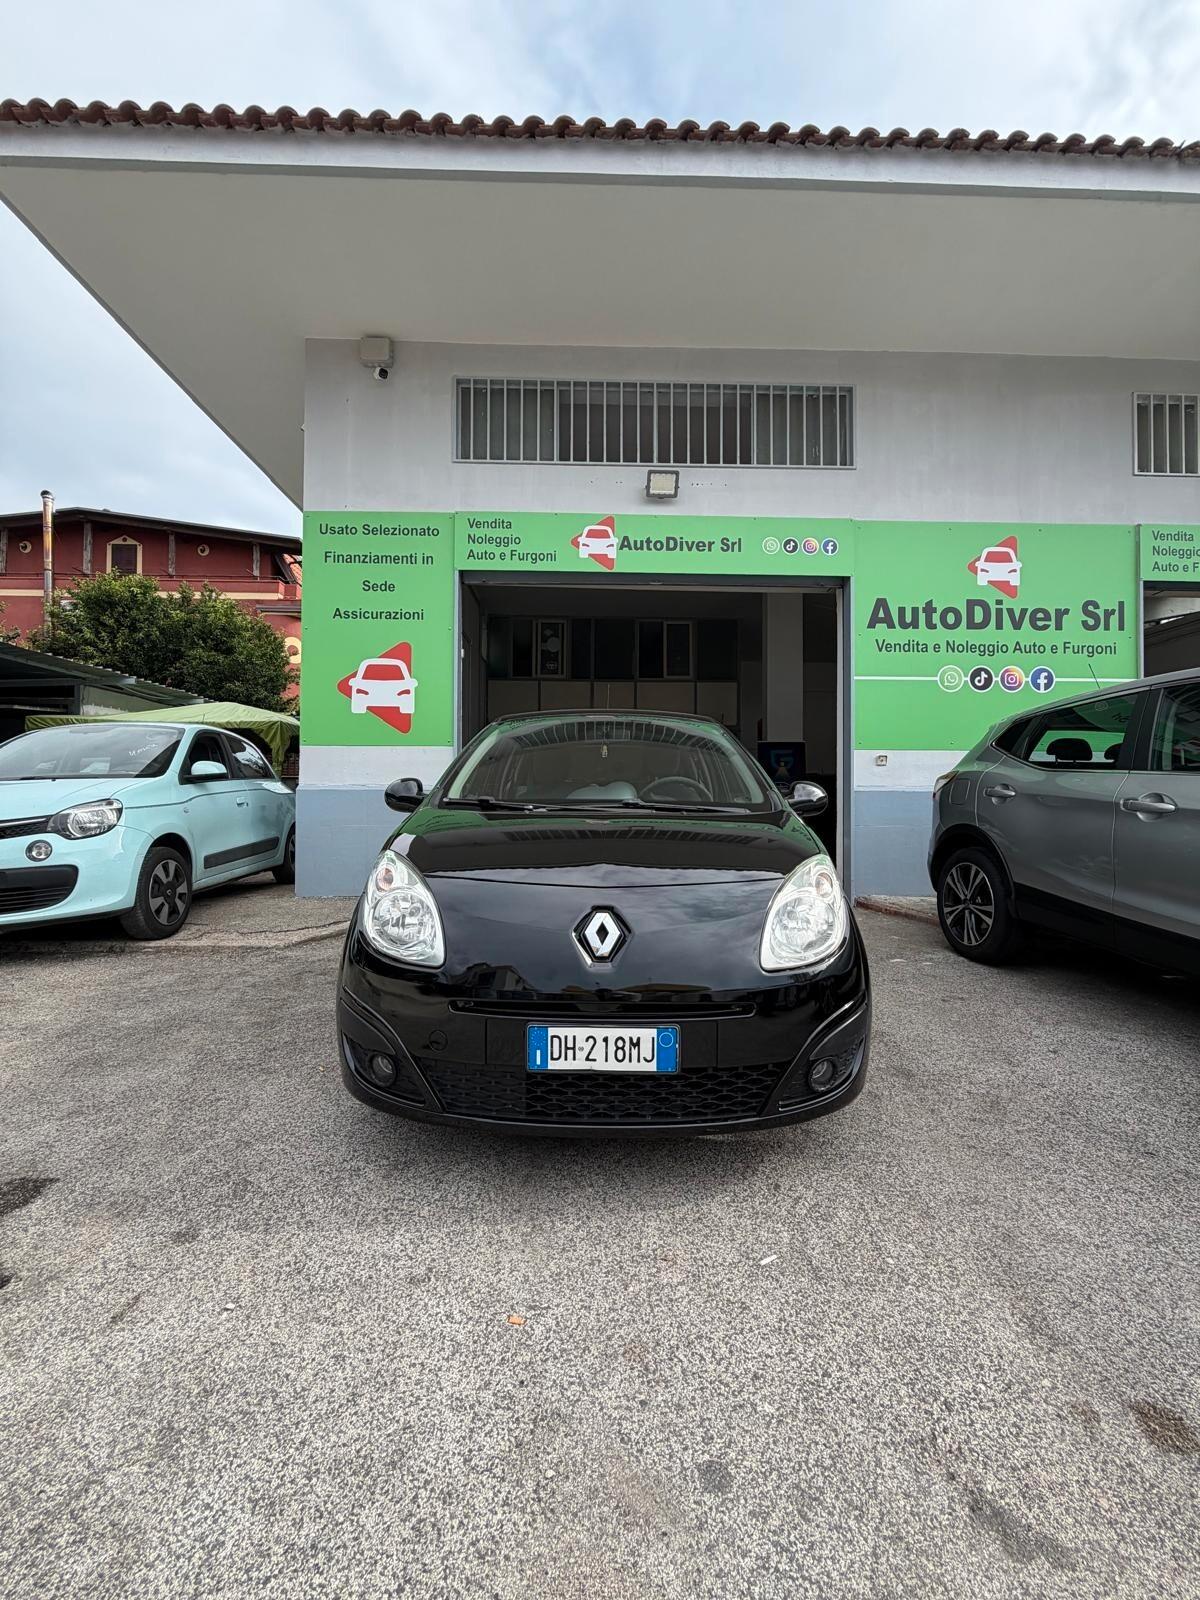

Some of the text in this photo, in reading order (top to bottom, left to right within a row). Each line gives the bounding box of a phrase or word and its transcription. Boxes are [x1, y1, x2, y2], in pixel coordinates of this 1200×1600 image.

[319, 523, 440, 537] Usato Selezionato
[466, 517, 512, 530] Vendita
[467, 533, 522, 548] Noleggio
[1151, 529, 1195, 542] Vendita
[618, 535, 742, 553] AutoDiver Srl
[324, 550, 434, 566] Finanziamenti in
[466, 548, 557, 565] Auto e Furgoni
[1151, 560, 1180, 573] Auto
[1182, 564, 1190, 573] e
[361, 579, 396, 593] Sede
[332, 607, 424, 621] Assicurazioni
[866, 597, 1126, 632] AutoDiver Srl
[874, 638, 1117, 658] Vendita e Noleggio Auto e Furgoni
